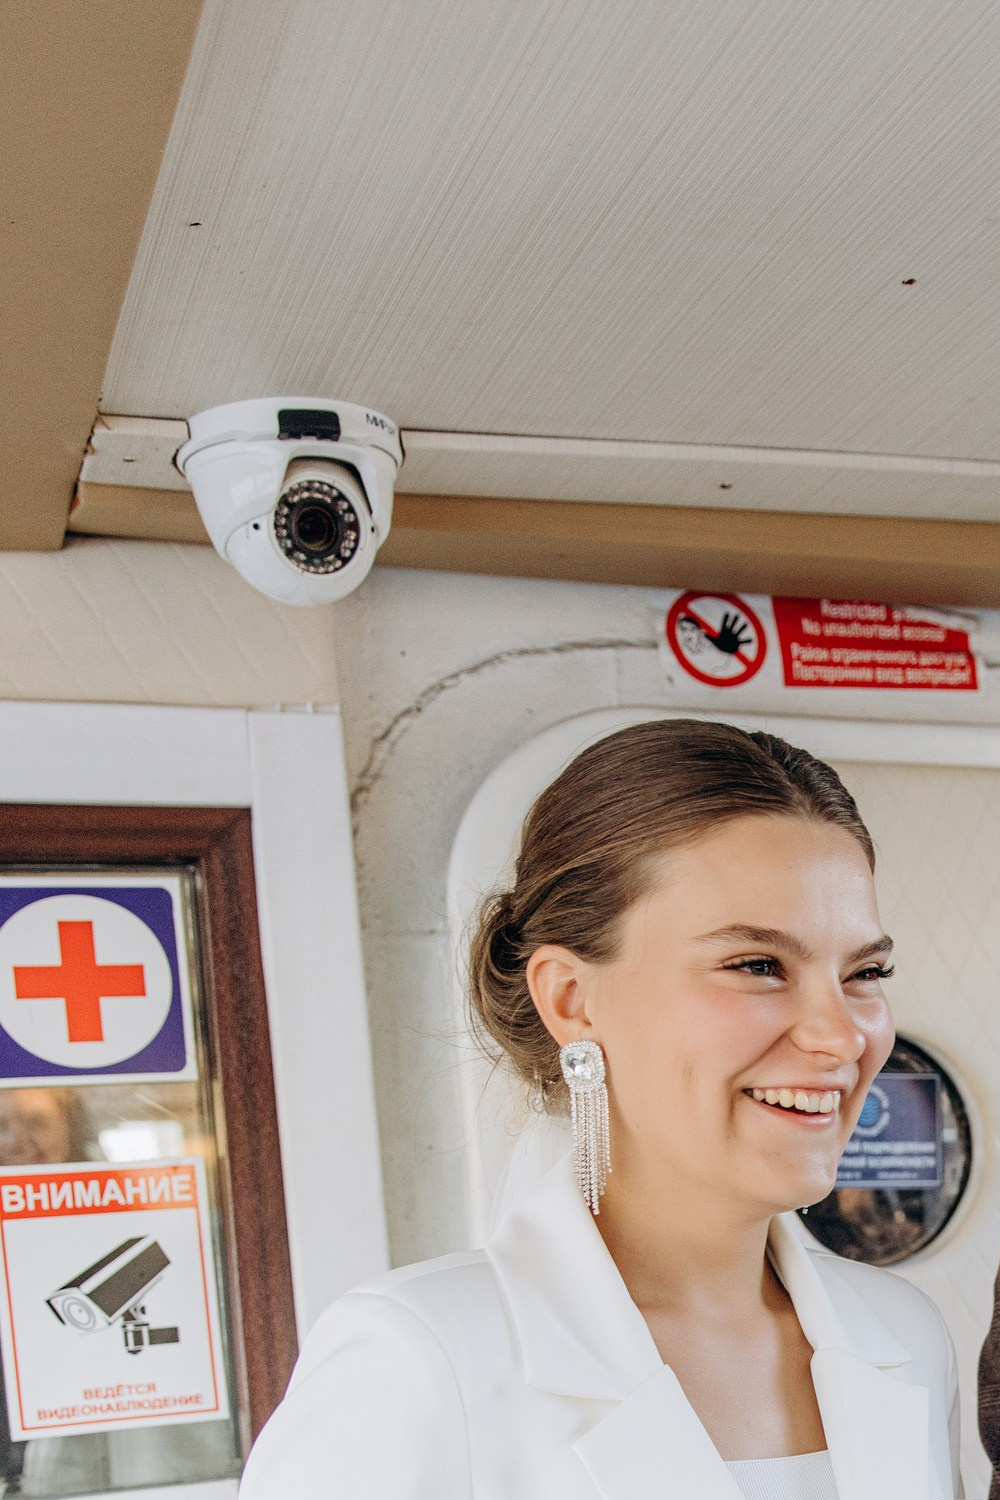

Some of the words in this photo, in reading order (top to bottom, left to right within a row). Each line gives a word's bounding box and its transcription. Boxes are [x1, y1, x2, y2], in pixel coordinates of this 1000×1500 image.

[801, 618, 821, 636] No
[790, 642, 829, 662] Район
[0, 1174, 193, 1212] ВНИМАНИЕ
[83, 1382, 157, 1400] ВЕДЁТСЯ
[37, 1394, 203, 1421] ВИДЕОНАБЛЮДЕНИЕ
